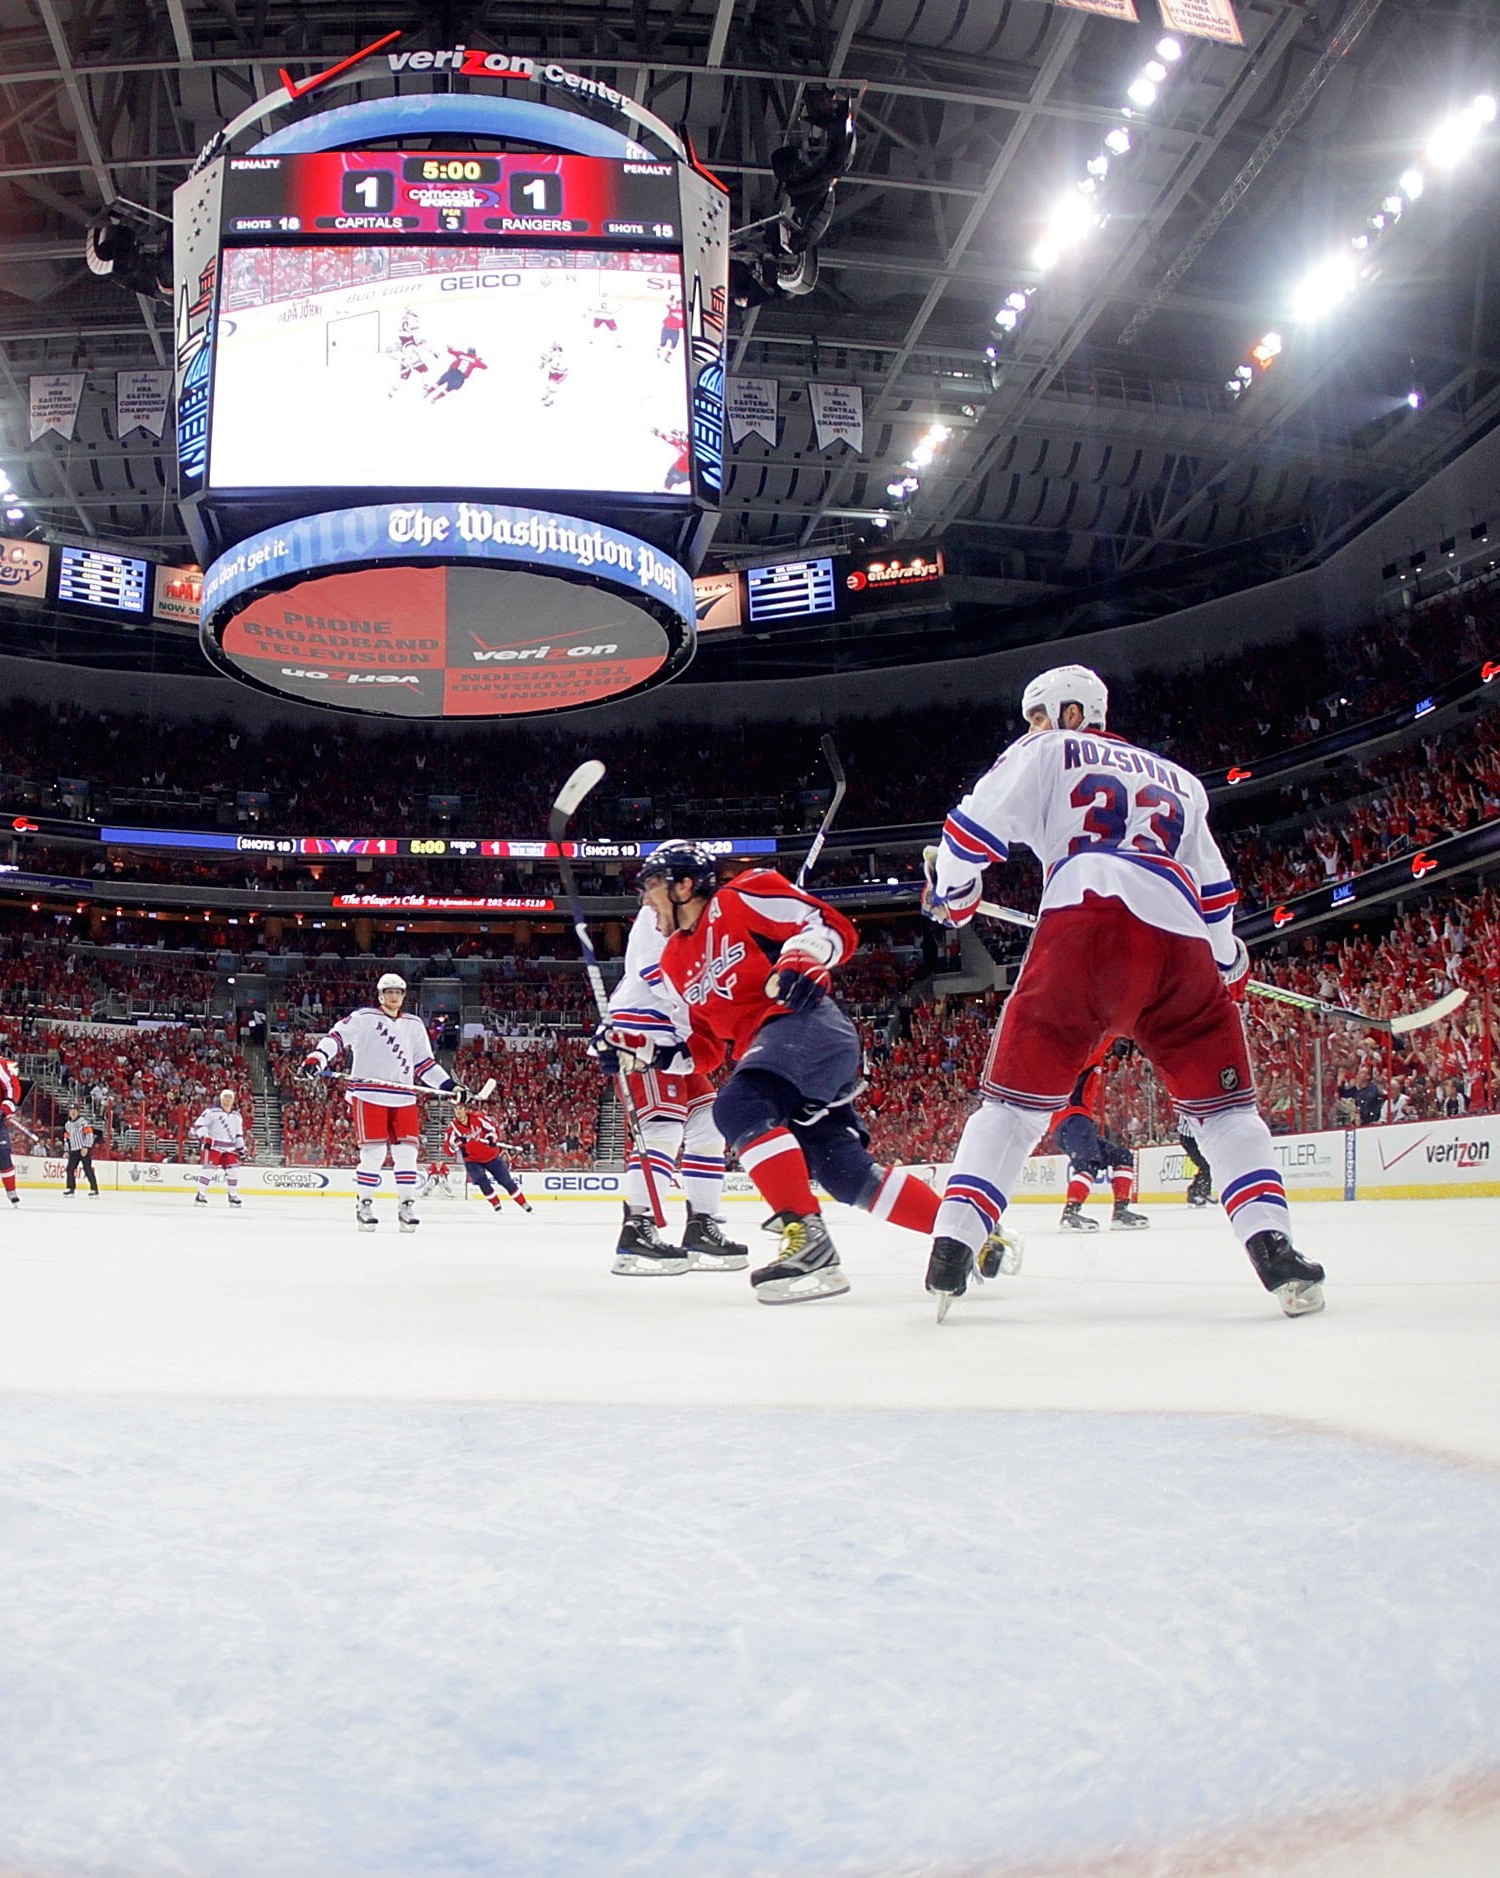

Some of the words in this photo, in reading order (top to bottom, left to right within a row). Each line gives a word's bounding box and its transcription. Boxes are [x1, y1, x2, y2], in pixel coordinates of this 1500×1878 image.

[388, 45, 533, 79] verizon
[545, 64, 631, 107] Center
[231, 160, 280, 170] PENALTY
[423, 161, 481, 180] 5:00
[623, 163, 672, 176] PENALTY
[356, 176, 378, 208] 1
[409, 188, 475, 200] comcast
[523, 179, 546, 210] 1
[442, 208, 461, 217] PER
[237, 220, 272, 230] SHOTS
[335, 217, 403, 229] CAPITALS
[446, 217, 459, 230] 3
[502, 218, 572, 231] RANGERS
[609, 223, 643, 234] SHOTS
[440, 273, 521, 292] GEICO
[729, 413, 775, 421] CHAMPIONS
[822, 406, 857, 414] CENTRAL
[822, 413, 856, 421] DIVISION
[817, 420, 861, 428] CHAMPIONS
[388, 508, 450, 547] The
[456, 502, 636, 573] Washington
[637, 546, 679, 595] Post
[219, 556, 246, 586] don't
[248, 548, 271, 572] get
[273, 540, 290, 560] it.
[867, 564, 938, 582] enterasys
[159, 601, 185, 613] NOW
[284, 611, 393, 634] PHONE
[244, 622, 440, 650] BROADBAND
[255, 640, 430, 663] TELEVISION
[473, 644, 618, 661] verizon
[281, 668, 420, 684] verizon
[1416, 697, 1433, 713] EMC
[1064, 738, 1190, 799] ROZSIVAL
[1068, 773, 1186, 860] 33
[376, 840, 386, 853] 1
[410, 840, 445, 854] 5:00
[1333, 884, 1352, 900] EMC
[341, 895, 359, 905] The
[362, 895, 399, 908] Player's
[402, 895, 425, 906] Club
[487, 899, 546, 907] 202-661-5110
[376, 1022, 410, 1074] RANGERS
[1346, 1130, 1355, 1188] Reebok
[1426, 1137, 1490, 1167] verizon
[43, 1160, 66, 1180] State
[266, 1170, 312, 1183] comcast
[544, 1177, 619, 1190] GEICO
